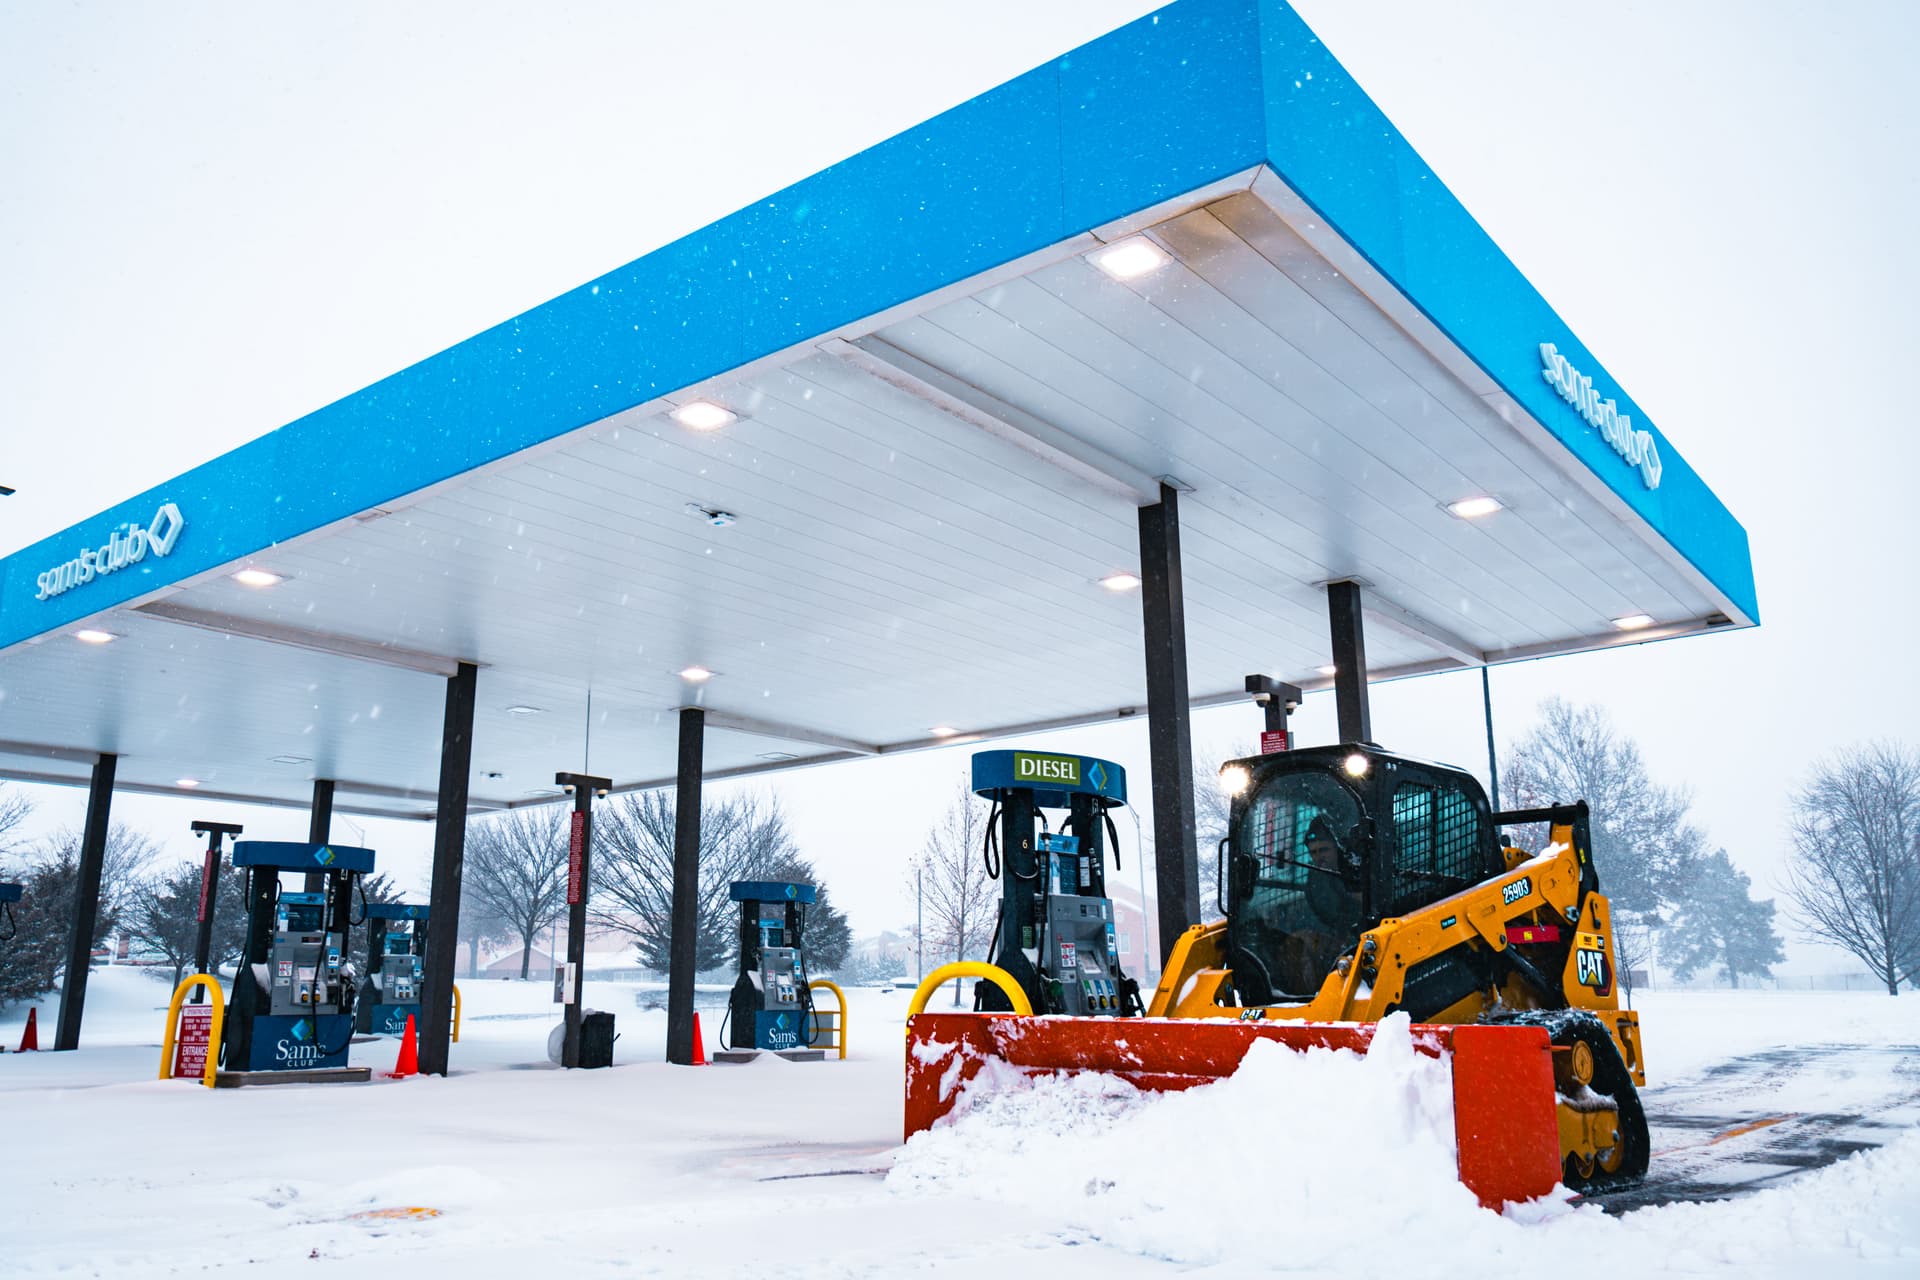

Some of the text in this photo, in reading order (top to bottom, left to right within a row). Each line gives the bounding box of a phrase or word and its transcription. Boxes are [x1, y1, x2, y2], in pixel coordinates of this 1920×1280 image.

[1021, 758, 1077, 780] DIESEL
[1022, 839, 1028, 849] 6
[1502, 878, 1530, 905] 259D3
[1577, 949, 1603, 985] CAT
[1240, 1009, 1263, 1020] CAT
[768, 1027, 797, 1044] Sam's
[287, 1058, 314, 1068] CLUB
